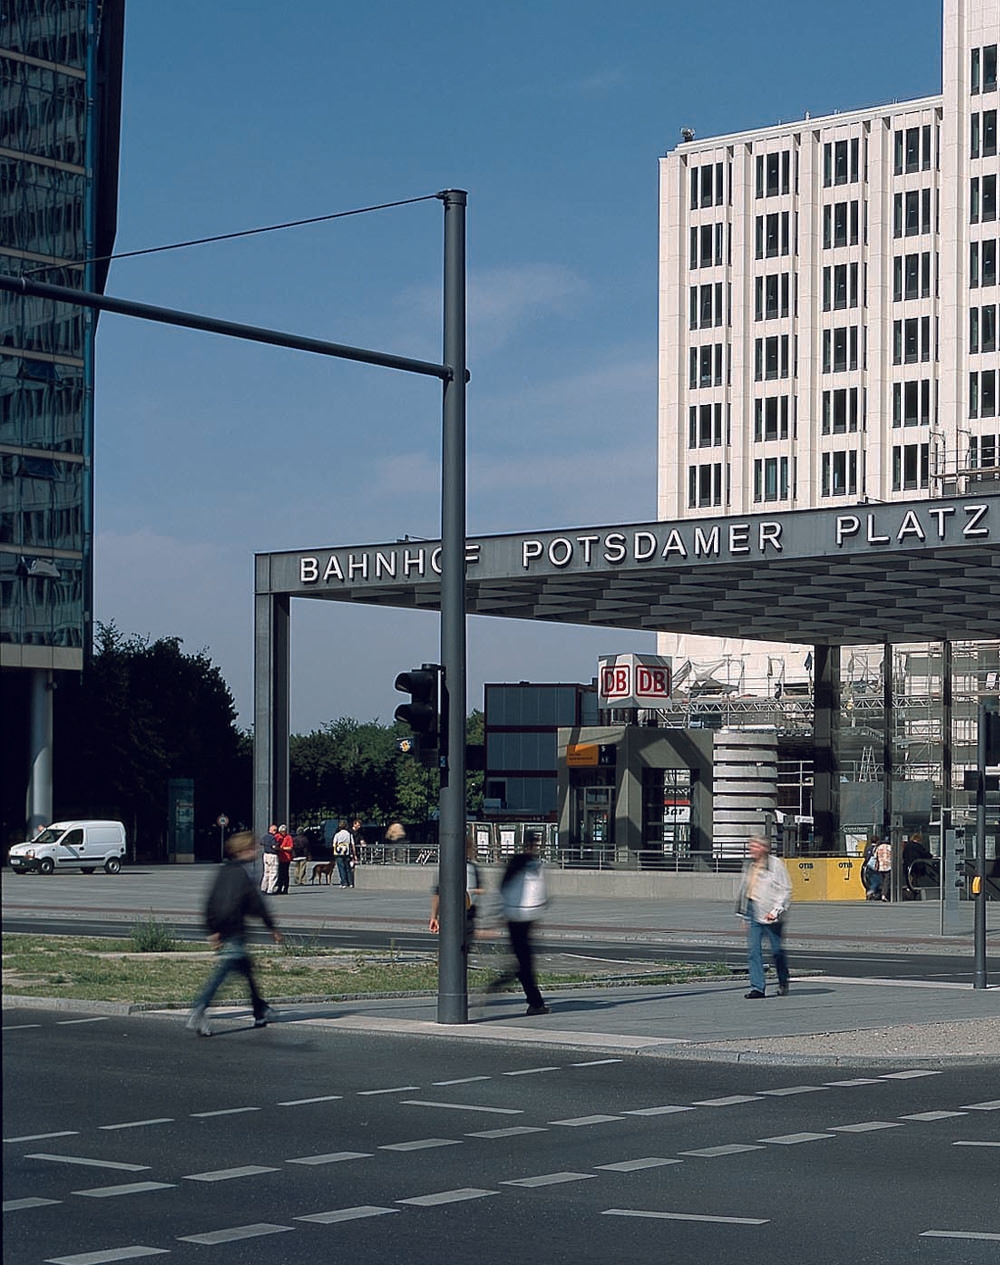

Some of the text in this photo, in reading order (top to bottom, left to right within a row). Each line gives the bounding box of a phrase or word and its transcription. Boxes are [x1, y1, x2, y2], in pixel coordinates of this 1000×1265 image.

[522, 521, 784, 568] POTSDAMER
[836, 503, 990, 545] PLATZ
[604, 670, 627, 693] DB
[640, 670, 666, 693] DB
